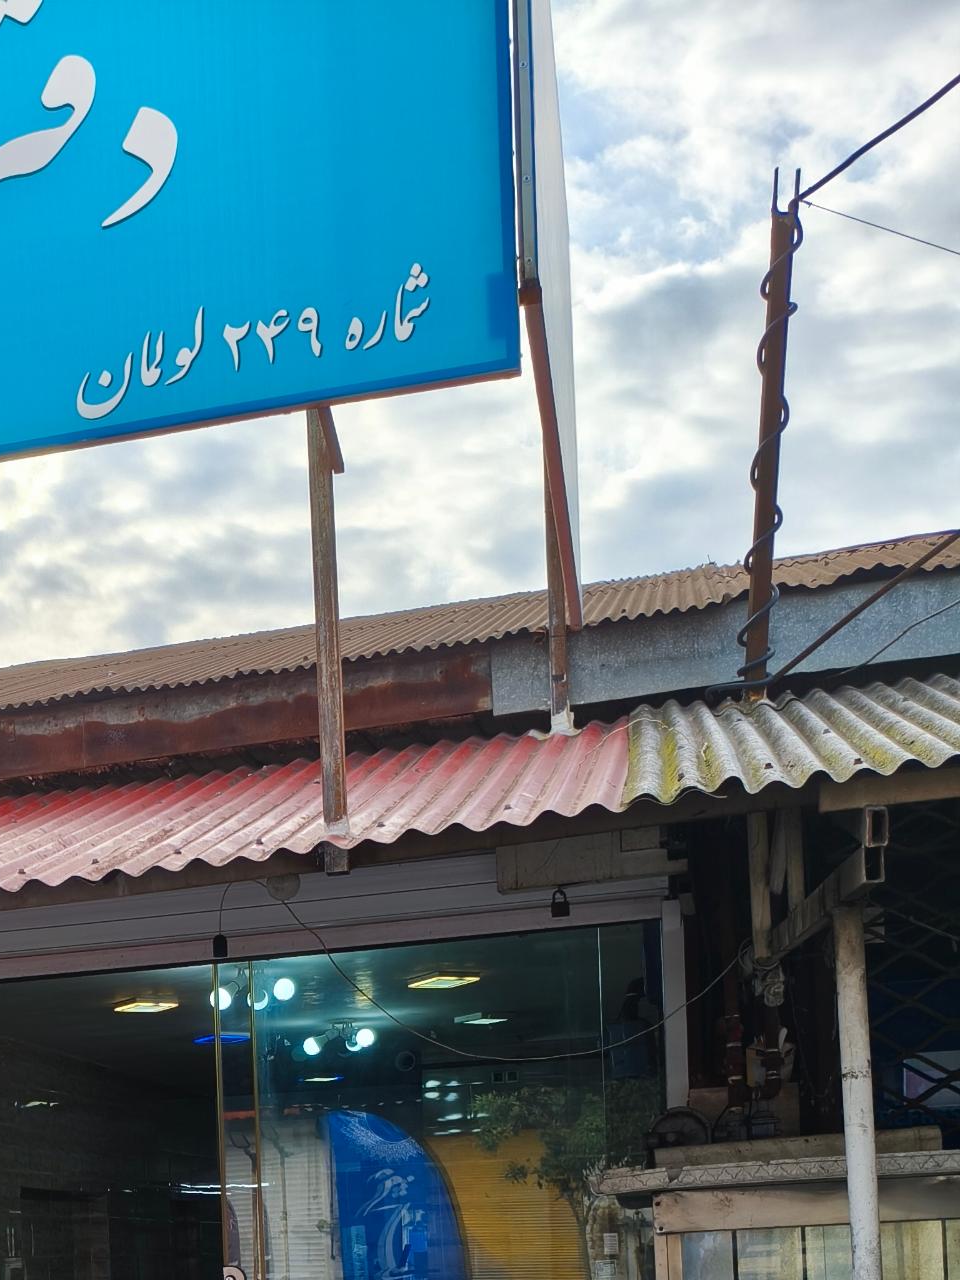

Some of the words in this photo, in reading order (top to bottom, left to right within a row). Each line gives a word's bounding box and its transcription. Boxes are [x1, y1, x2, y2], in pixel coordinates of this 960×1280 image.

[223, 308, 322, 371] ۲۴۹
[345, 263, 430, 351] شماره
[76, 307, 204, 419] لولمان
